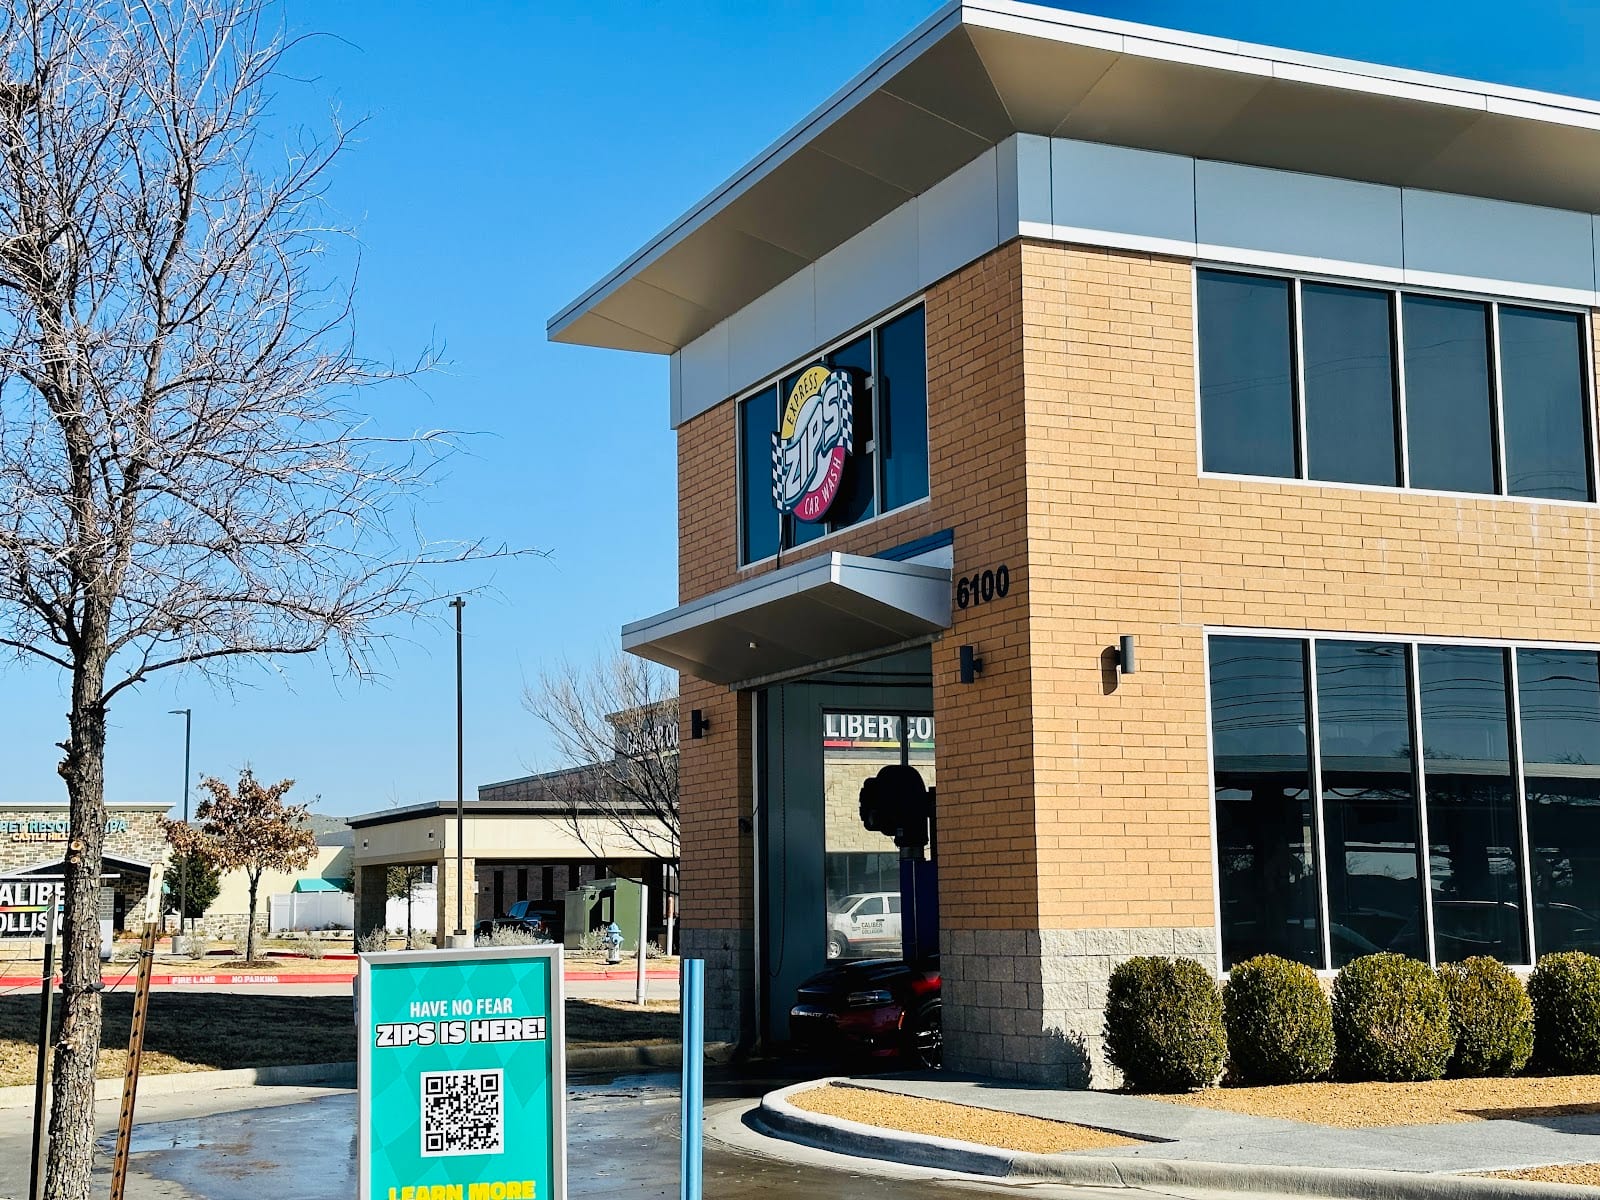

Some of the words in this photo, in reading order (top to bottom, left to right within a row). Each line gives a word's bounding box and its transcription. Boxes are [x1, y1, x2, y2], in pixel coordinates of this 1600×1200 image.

[786, 372, 818, 425] EXPRESS
[785, 382, 839, 500] ZIPS
[804, 494, 820, 515] CAR
[821, 456, 841, 503] WASH
[957, 564, 1009, 609] 6100
[823, 714, 893, 738] LIBER
[907, 716, 936, 739] CO
[28, 821, 70, 832] RESO
[48, 832, 69, 841] HILL
[0, 882, 65, 906] ALIBE
[172, 976, 192, 984] FIRE
[193, 976, 216, 984] LANE
[231, 975, 243, 983] NO
[244, 975, 278, 983] PARKING
[410, 1001, 448, 1018] HAVE
[452, 1000, 473, 1016] NO
[476, 998, 513, 1014] FEAR
[375, 1021, 436, 1047] ZIPS
[439, 1020, 466, 1045] IS
[470, 1017, 547, 1043] HERE!
[389, 1184, 463, 1200] LEARN
[468, 1180, 536, 1200] MORE
